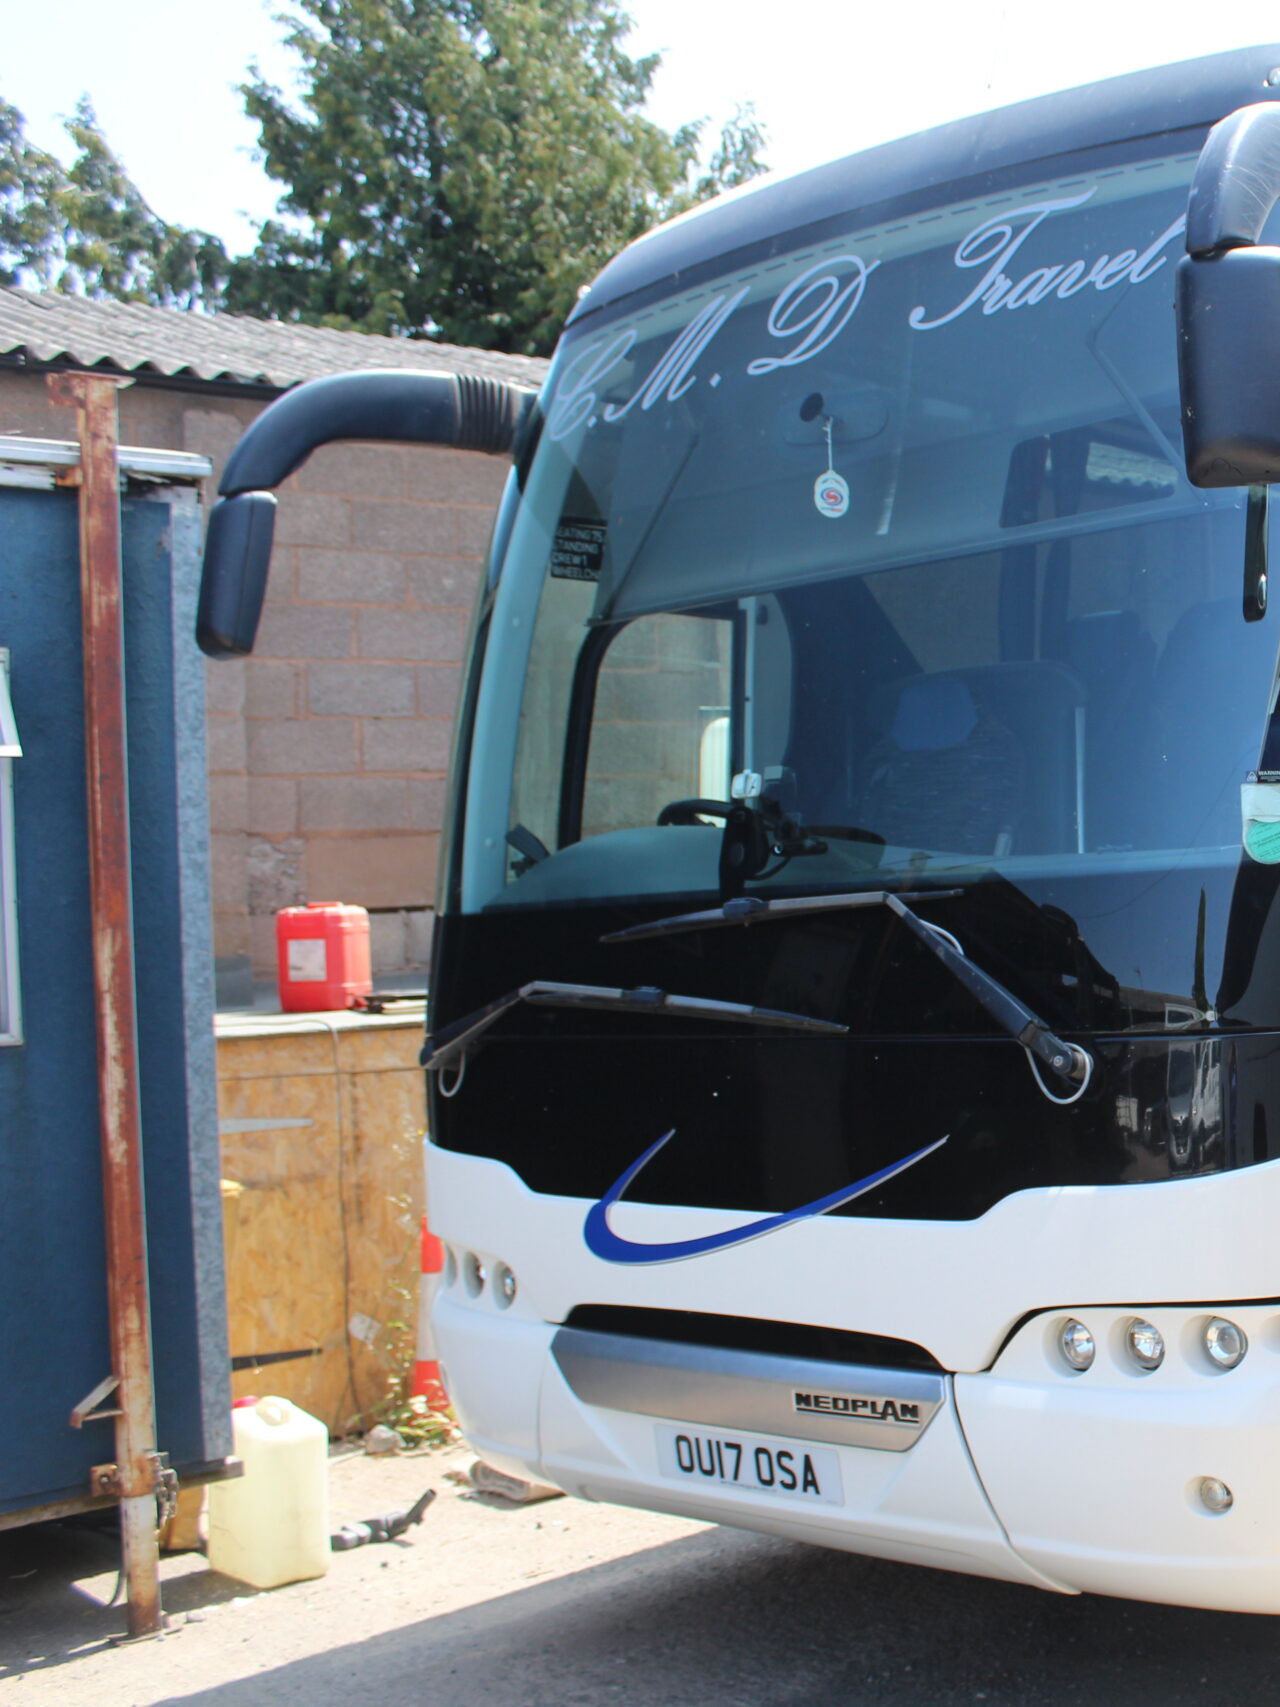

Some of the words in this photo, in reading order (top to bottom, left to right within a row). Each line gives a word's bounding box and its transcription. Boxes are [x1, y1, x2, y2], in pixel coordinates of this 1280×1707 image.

[908, 185, 1186, 332] Travel
[795, 1392, 919, 1424] NEOPLAN
[675, 1434, 742, 1482] OU17
[754, 1447, 820, 1495] OSA
